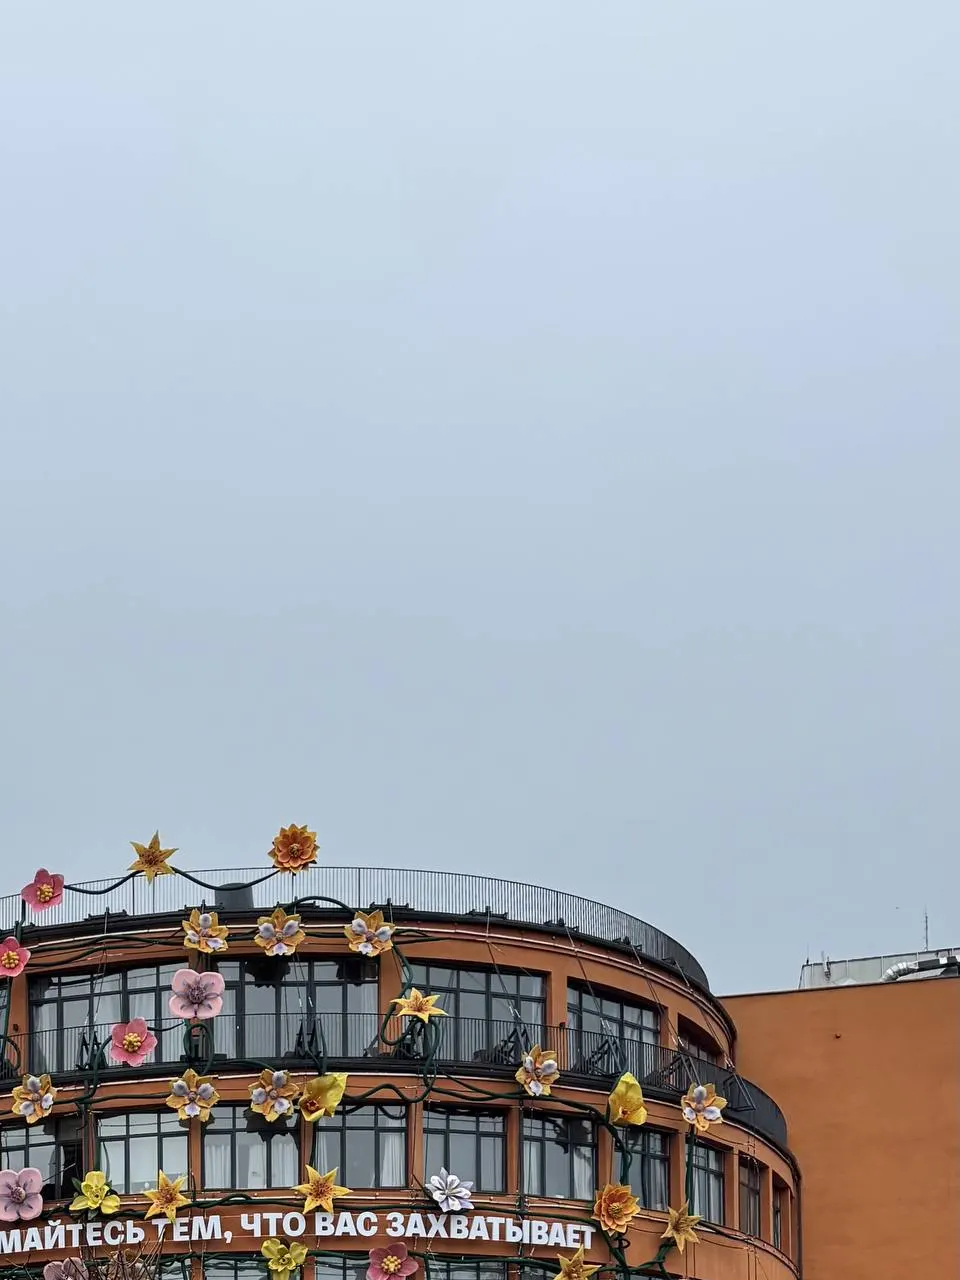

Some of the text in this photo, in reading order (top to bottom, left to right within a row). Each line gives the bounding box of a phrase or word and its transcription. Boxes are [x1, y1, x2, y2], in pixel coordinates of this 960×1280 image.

[151, 1214, 233, 1244] ТЕМ,
[240, 1212, 307, 1239] ЧТО
[315, 1211, 378, 1238] ВАС
[386, 1212, 597, 1250] ЗАХВАТЫВАЕТ
